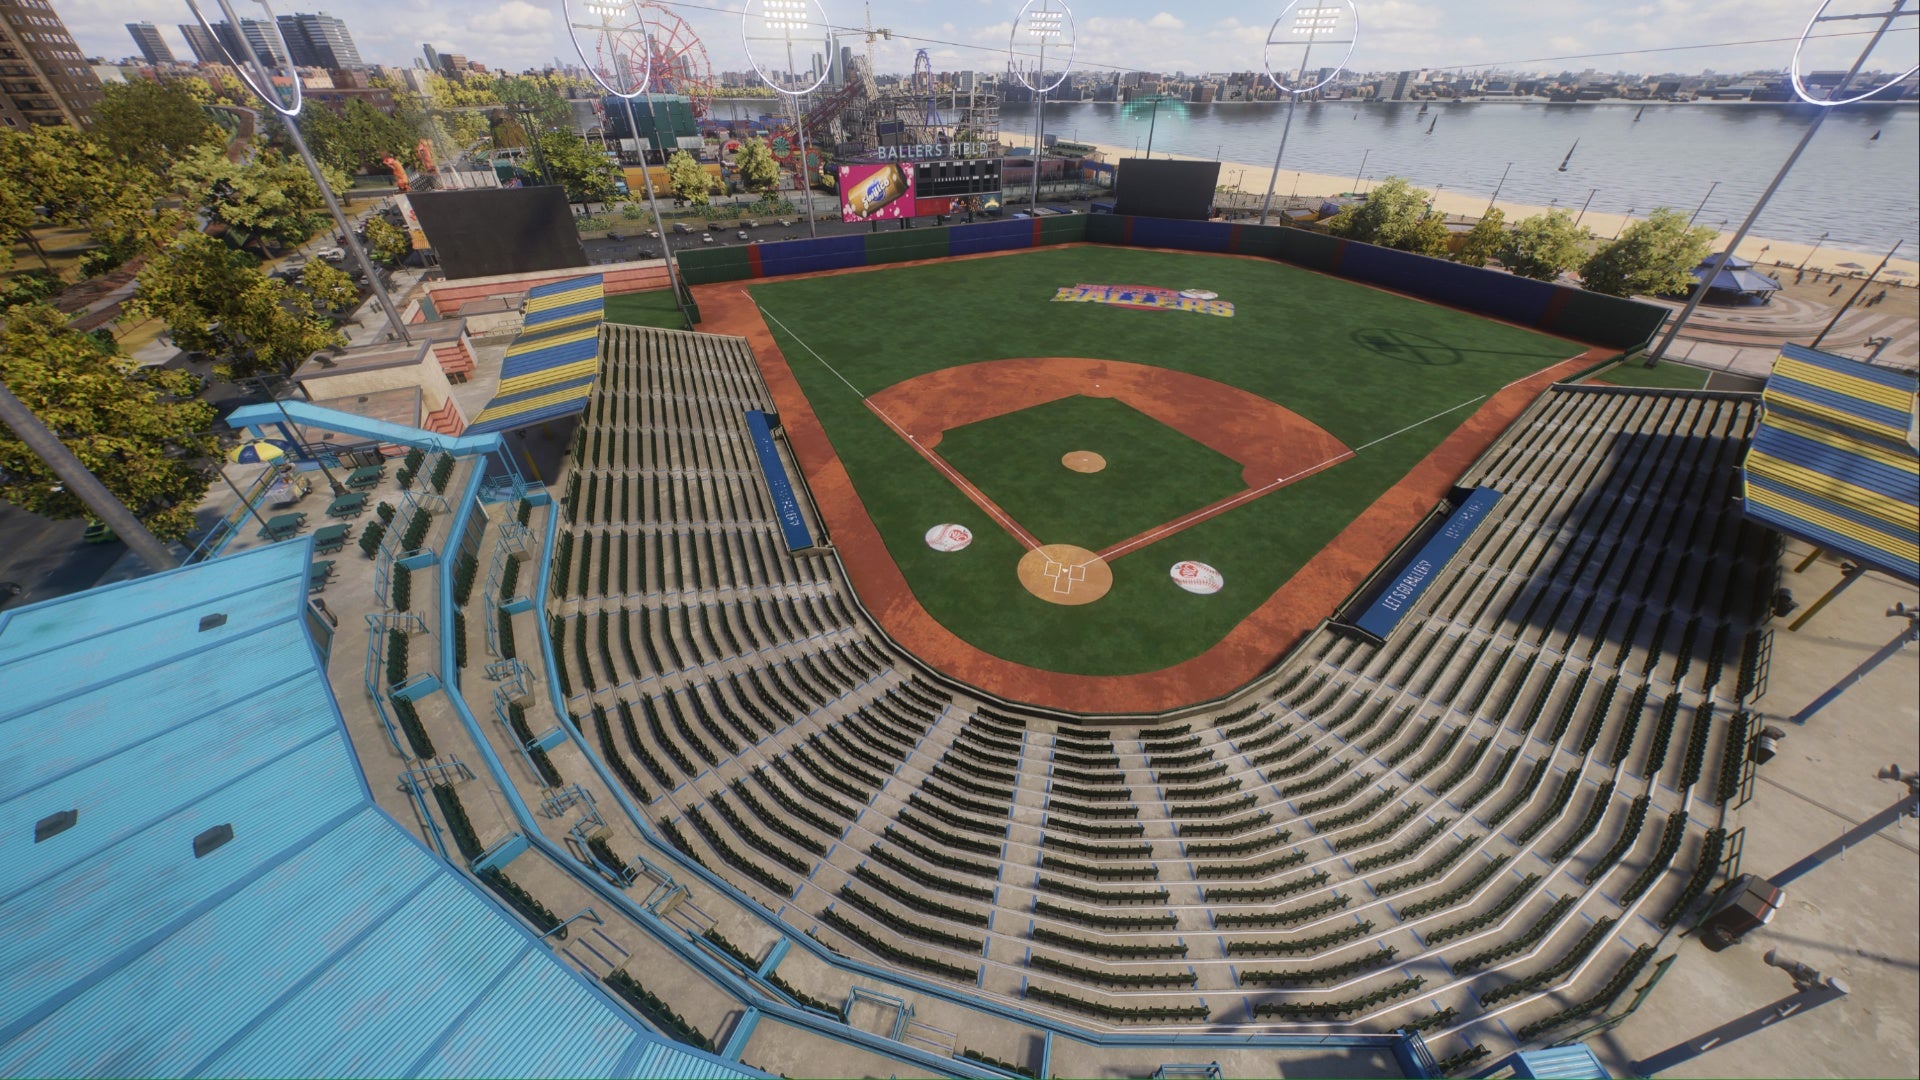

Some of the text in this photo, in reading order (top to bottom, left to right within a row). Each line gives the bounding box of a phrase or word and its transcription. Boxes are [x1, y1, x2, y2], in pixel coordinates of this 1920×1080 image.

[877, 142, 988, 160] BALLERS FIELD
[1381, 590, 1407, 611] LETS
